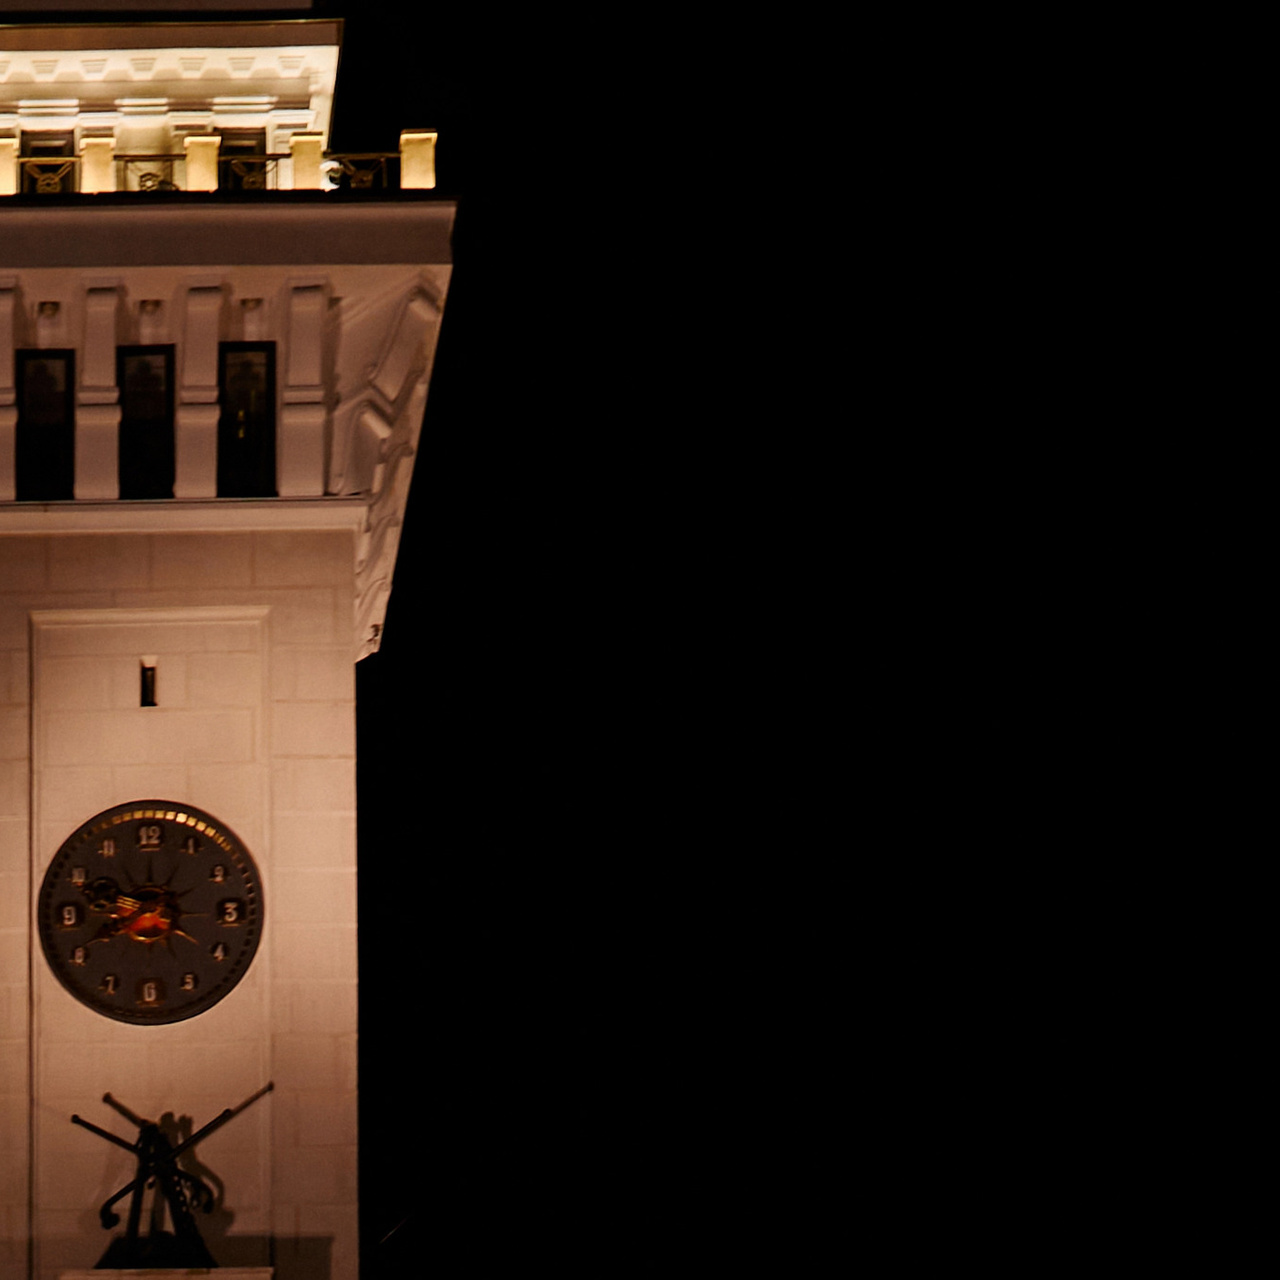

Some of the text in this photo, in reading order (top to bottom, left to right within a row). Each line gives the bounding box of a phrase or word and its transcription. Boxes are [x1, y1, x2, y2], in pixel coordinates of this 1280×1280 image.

[138, 826, 162, 845] 12
[62, 906, 76, 925] 9
[224, 902, 238, 922] 3
[213, 945, 225, 961] 4
[104, 976, 115, 991] 7
[183, 974, 193, 989] 5
[143, 982, 156, 1002] 6
